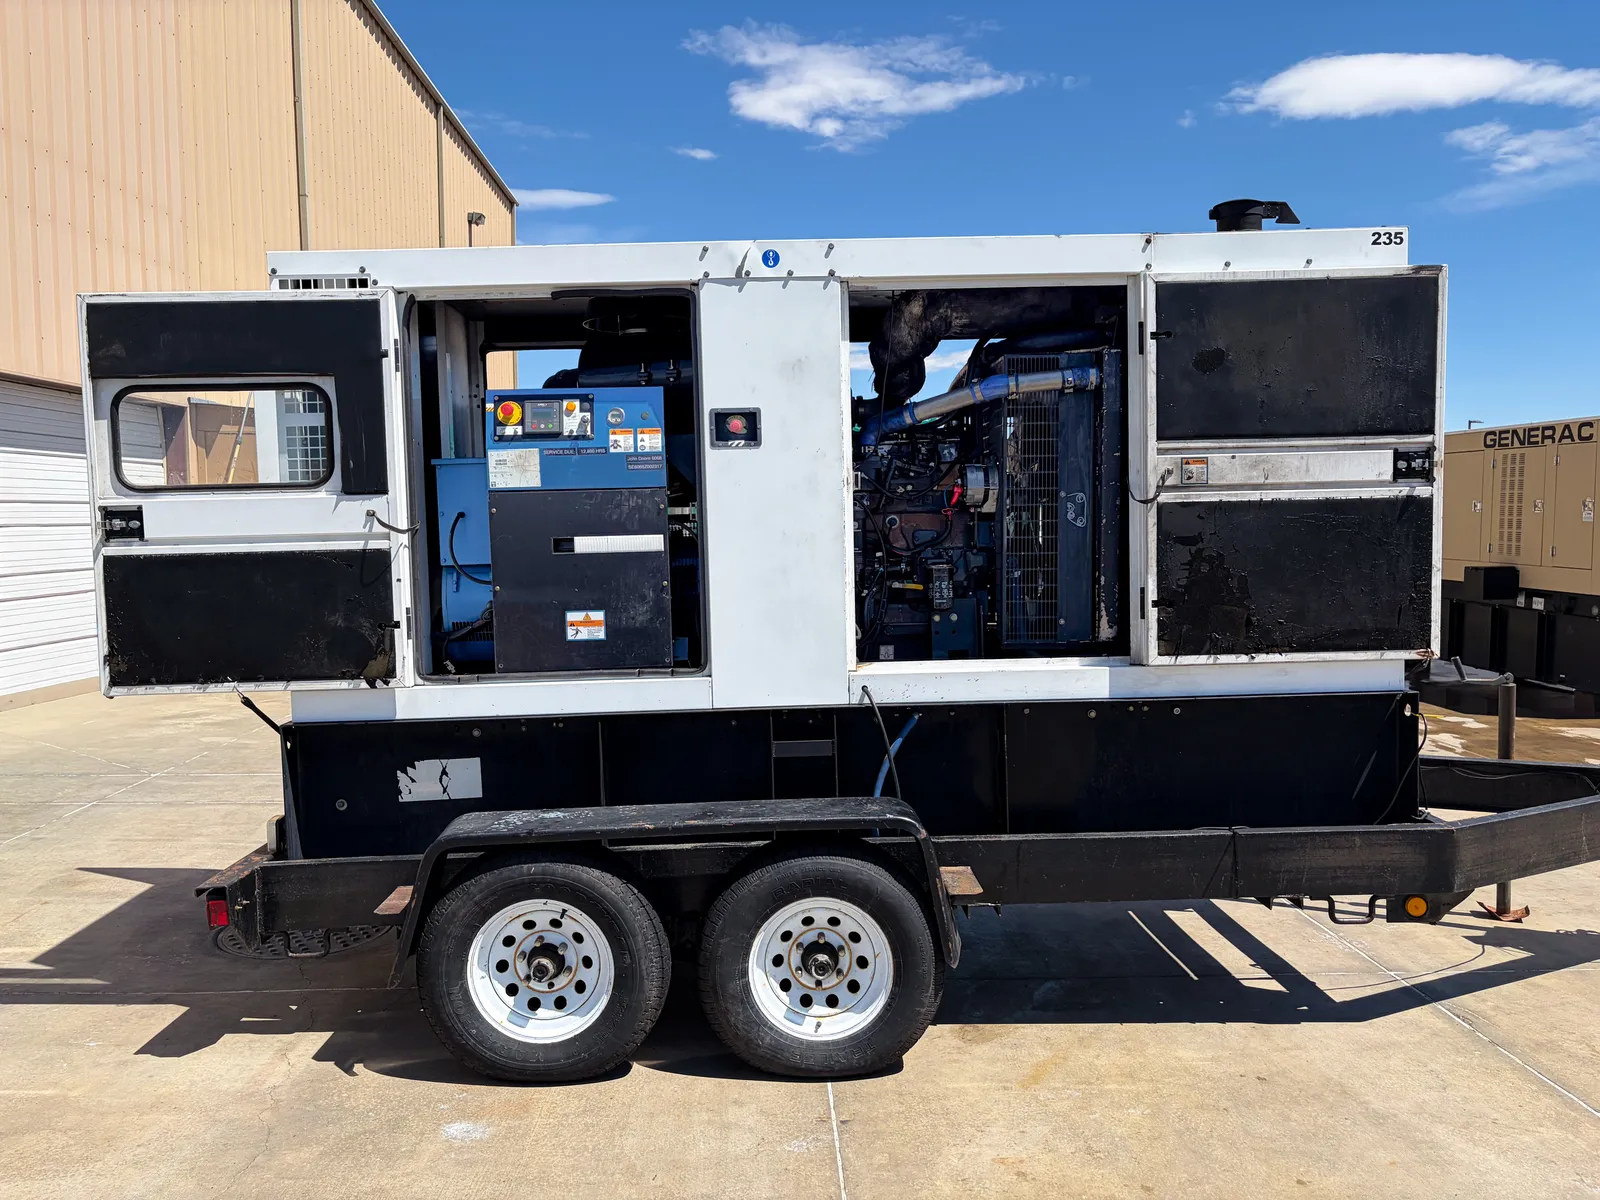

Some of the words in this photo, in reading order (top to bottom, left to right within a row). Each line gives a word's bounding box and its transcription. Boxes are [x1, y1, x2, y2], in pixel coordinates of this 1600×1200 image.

[1371, 231, 1404, 246] 235
[1483, 421, 1594, 449] GENERAC
[771, 876, 848, 900] RADIAL
